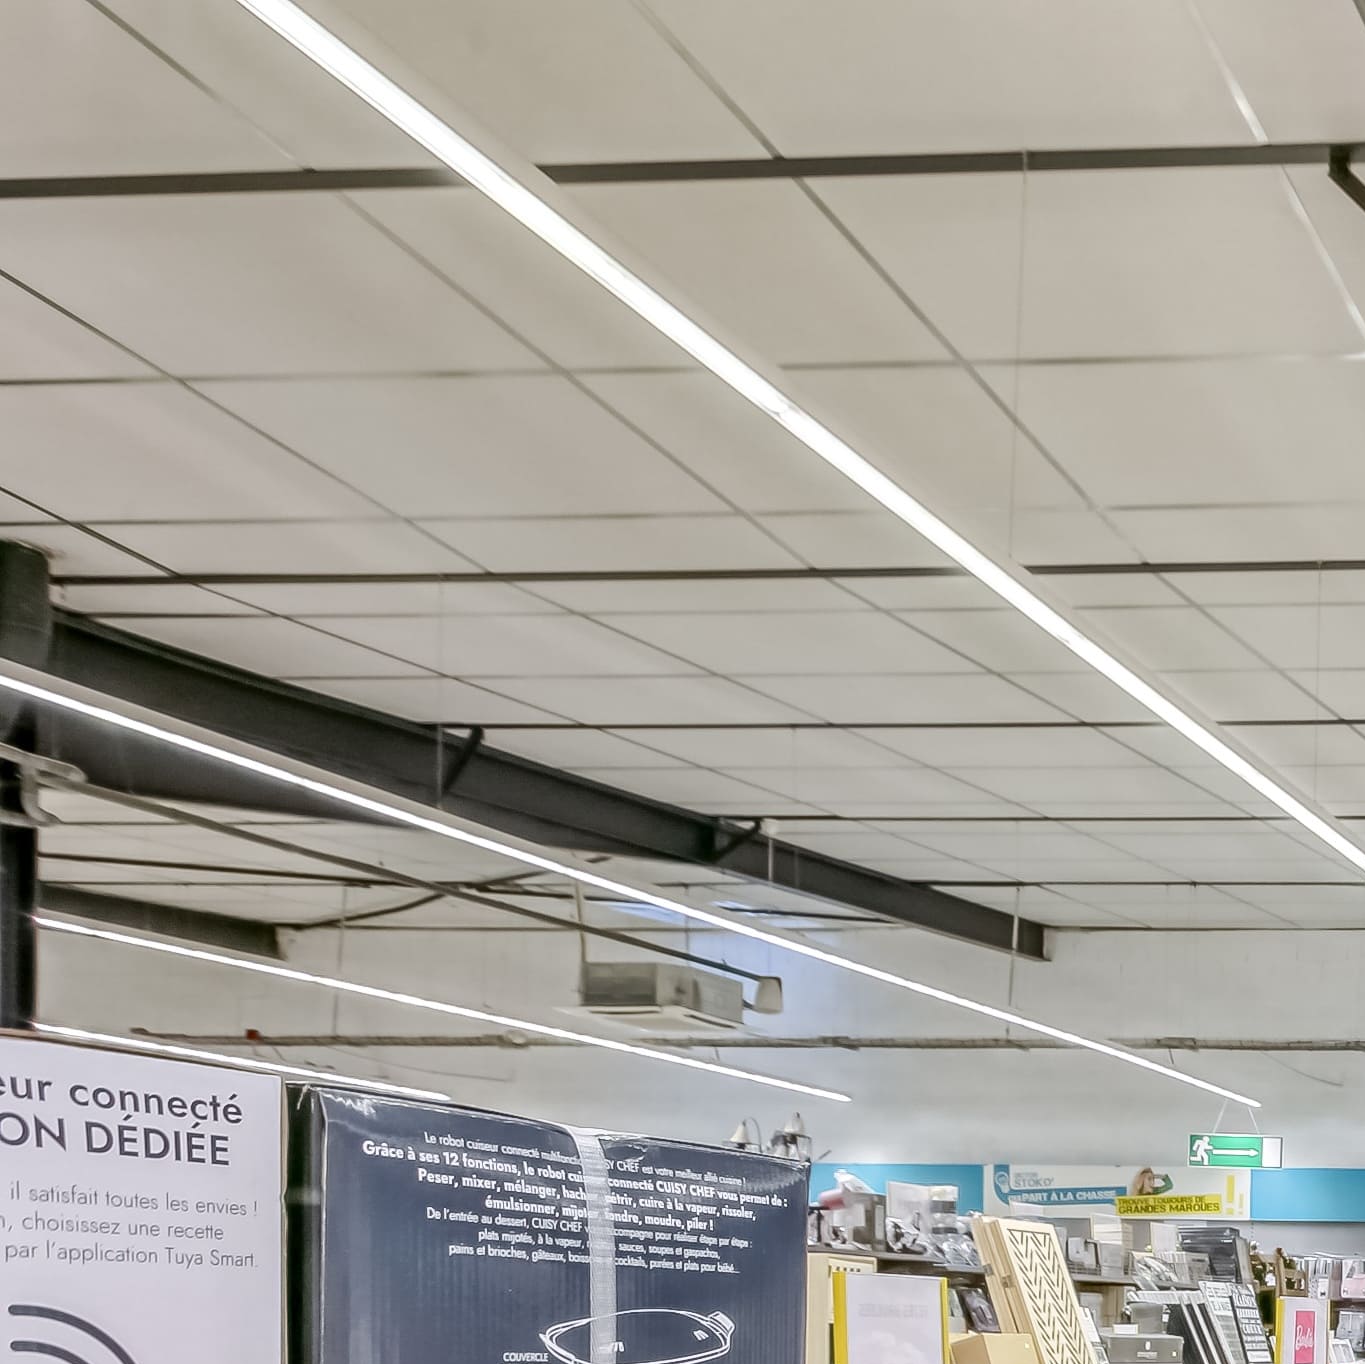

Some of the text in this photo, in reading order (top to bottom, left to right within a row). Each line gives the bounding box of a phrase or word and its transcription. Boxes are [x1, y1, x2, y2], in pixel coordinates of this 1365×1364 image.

[69, 1084, 243, 1124] connecté
[85, 1114, 230, 1166] DÉDIÉE
[362, 1140, 404, 1159] Grâce
[407, 1146, 416, 1161] à
[419, 1152, 440, 1164] ses
[443, 1151, 460, 1167] 12
[463, 1153, 521, 1176] fonctions,
[524, 1161, 535, 1175] le
[538, 1165, 566, 1180] robot
[10, 1181, 248, 1216] il satisfait toutes les envies
[418, 1167, 560, 1200] Peser, mixer, mélanger,
[1060, 1192, 1074, 1200] LA
[485, 1194, 560, 1217] émulsionner,
[1118, 1202, 1220, 1214] GRANDES MARQUES
[22, 1212, 224, 1240] choisissez une recette
[5, 1240, 259, 1270] par l'application Tuya Smart.
[503, 1352, 549, 1362] COUVERCLE
